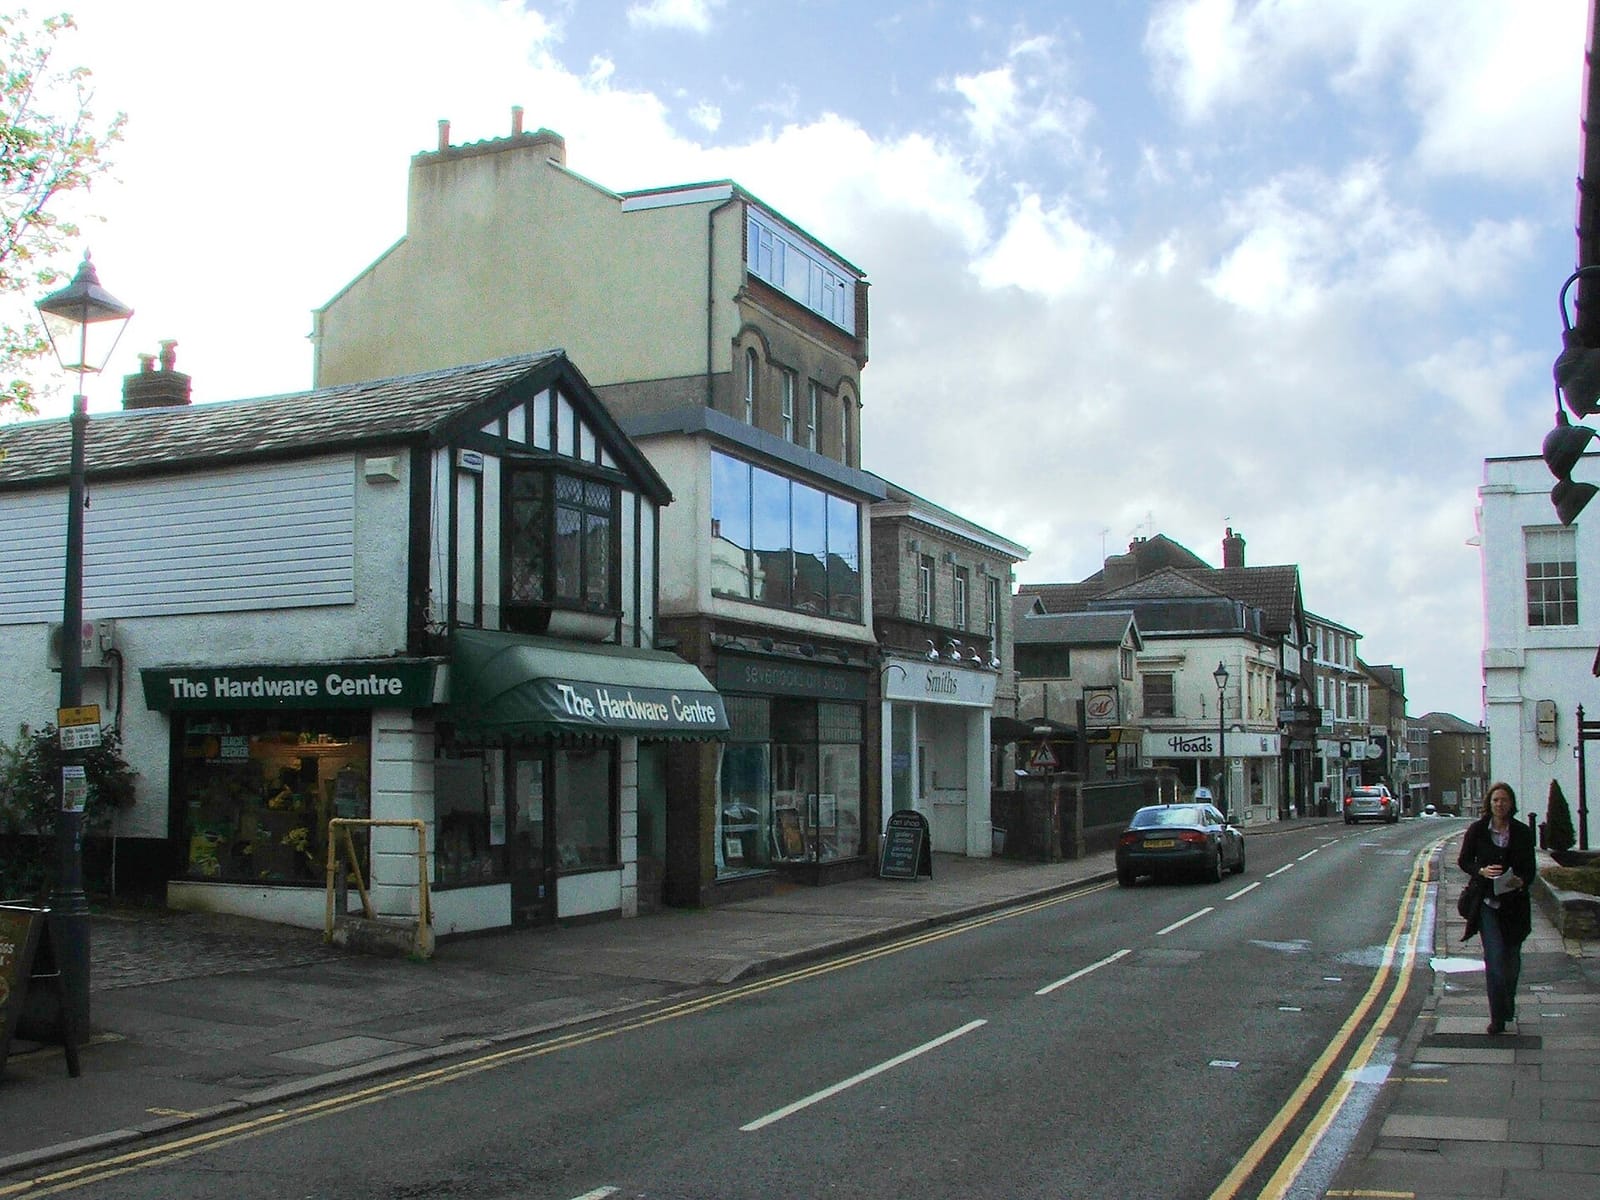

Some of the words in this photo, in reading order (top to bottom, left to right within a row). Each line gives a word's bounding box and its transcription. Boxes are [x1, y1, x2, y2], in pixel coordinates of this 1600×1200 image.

[170, 678, 208, 699] The
[214, 675, 318, 698] Hardware
[325, 673, 403, 696] Centre
[926, 669, 957, 695] Smiths
[557, 684, 595, 717] The
[597, 688, 669, 721] Hardware
[672, 694, 716, 723] Centre
[1168, 735, 1213, 753] Hoad's
